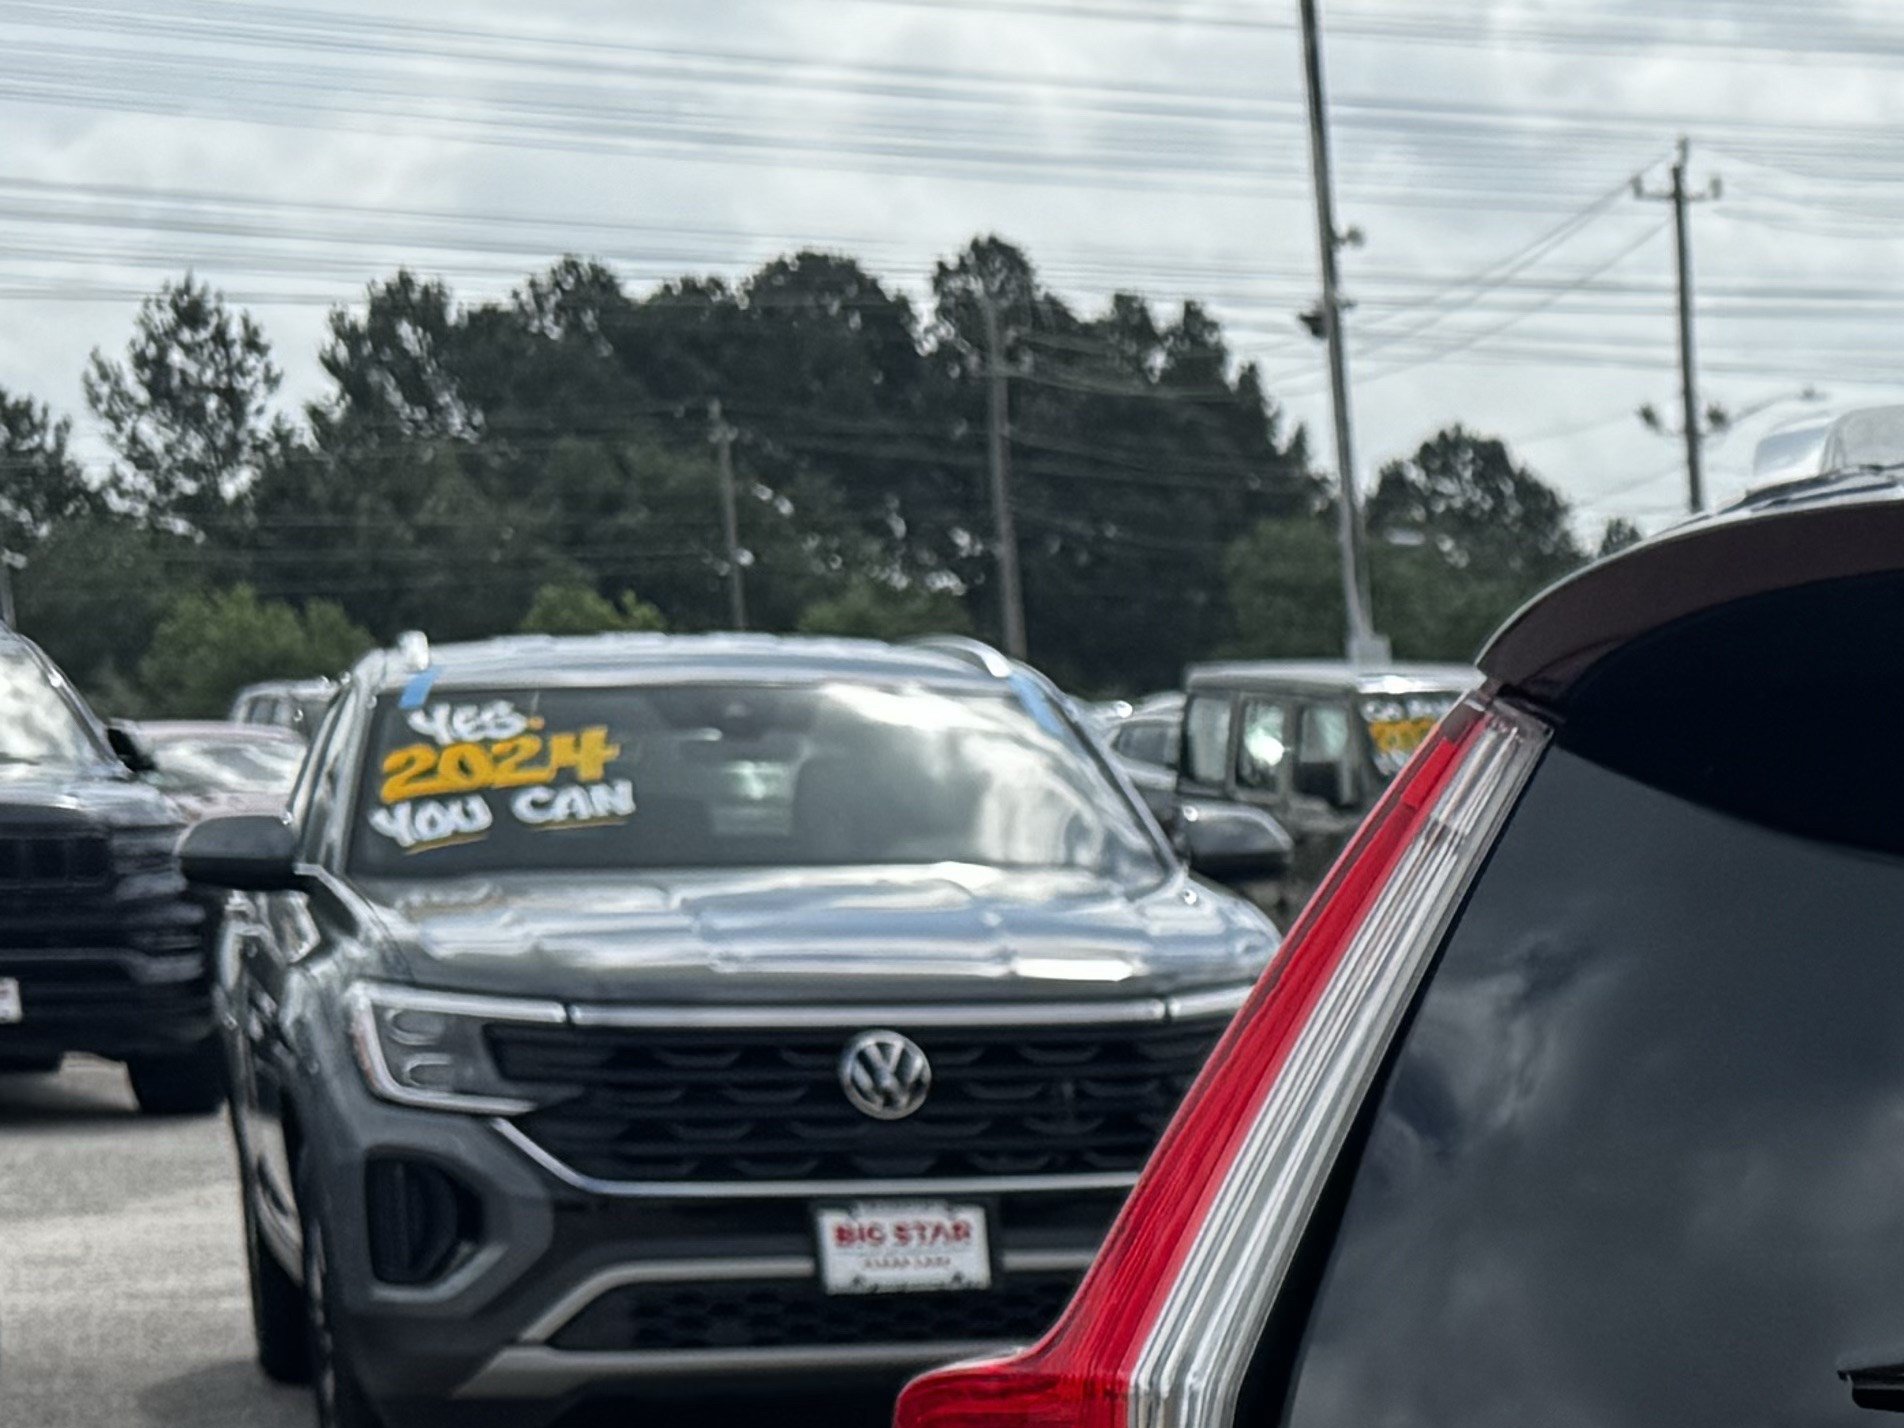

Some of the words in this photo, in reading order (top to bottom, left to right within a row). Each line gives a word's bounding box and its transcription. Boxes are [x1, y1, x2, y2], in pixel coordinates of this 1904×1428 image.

[380, 726, 621, 804] 2024
[368, 794, 493, 847] YOU
[511, 779, 636, 825] CAN
